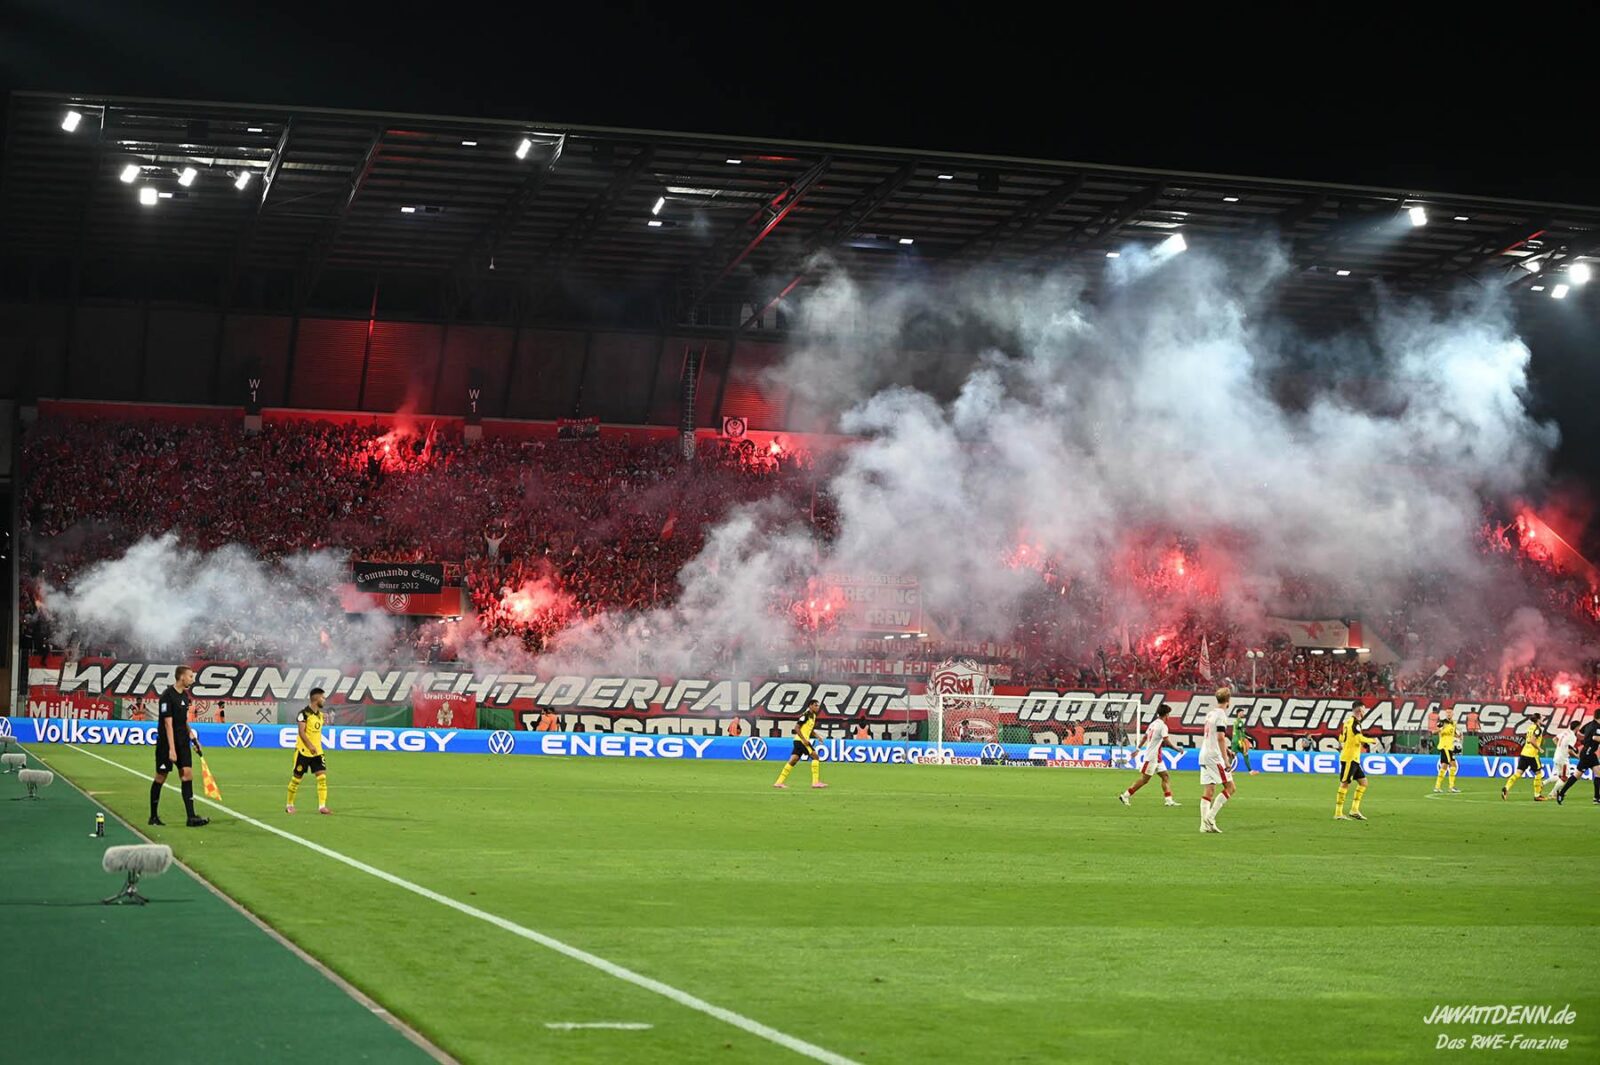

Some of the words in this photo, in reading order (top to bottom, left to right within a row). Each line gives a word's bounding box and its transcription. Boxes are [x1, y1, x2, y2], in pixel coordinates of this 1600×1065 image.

[357, 567, 409, 583] Commando
[411, 569, 440, 585] Essen
[401, 582, 420, 590] 2012
[59, 661, 180, 695] WIR
[192, 665, 342, 699] SIND
[349, 671, 537, 704] NICHT
[537, 676, 659, 710] DER
[665, 679, 906, 716] FAVORIT
[1018, 690, 1164, 724] DOCH
[1182, 694, 1352, 729] BEREIT
[1361, 701, 1510, 734] ALLES
[1516, 705, 1588, 737] ZU
[541, 734, 715, 758] ENERGY
[951, 757, 978, 765] ERGO
[1262, 753, 1413, 775] ENEGY
